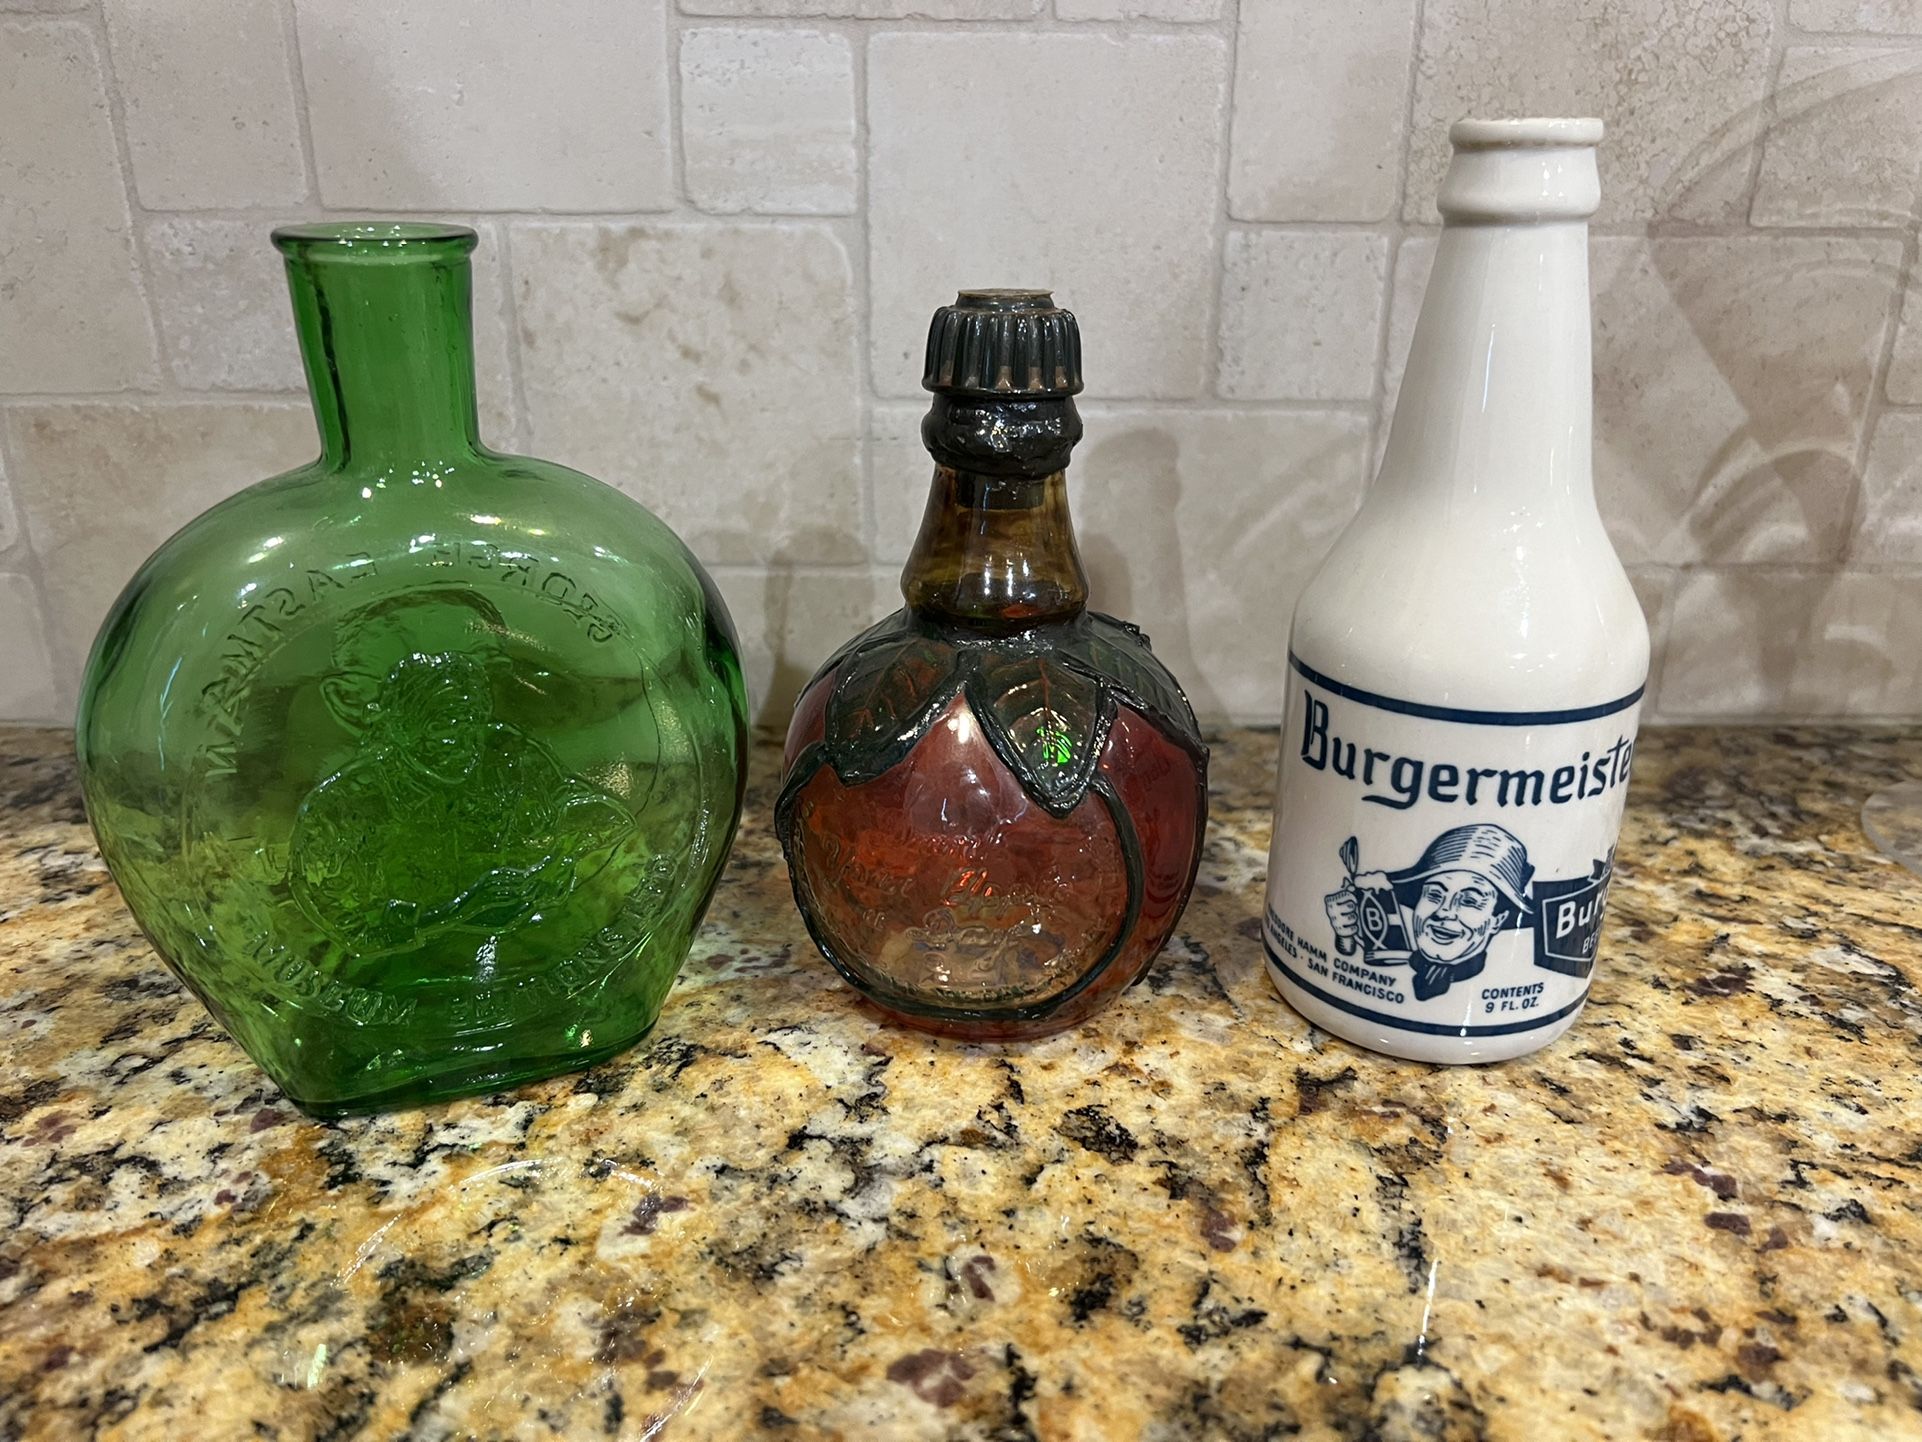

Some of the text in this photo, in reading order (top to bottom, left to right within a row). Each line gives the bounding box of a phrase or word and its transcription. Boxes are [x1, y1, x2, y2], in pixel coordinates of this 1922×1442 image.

[1366, 907, 1383, 931] B
[1297, 936, 1327, 962] HAMM
[1333, 958, 1396, 987] COMPANY
[1307, 958, 1328, 978] SAN
[1332, 971, 1405, 1004] FRANCISCO
[1481, 982, 1544, 1000] CONTENTS
[1485, 1002, 1494, 1013] 9
